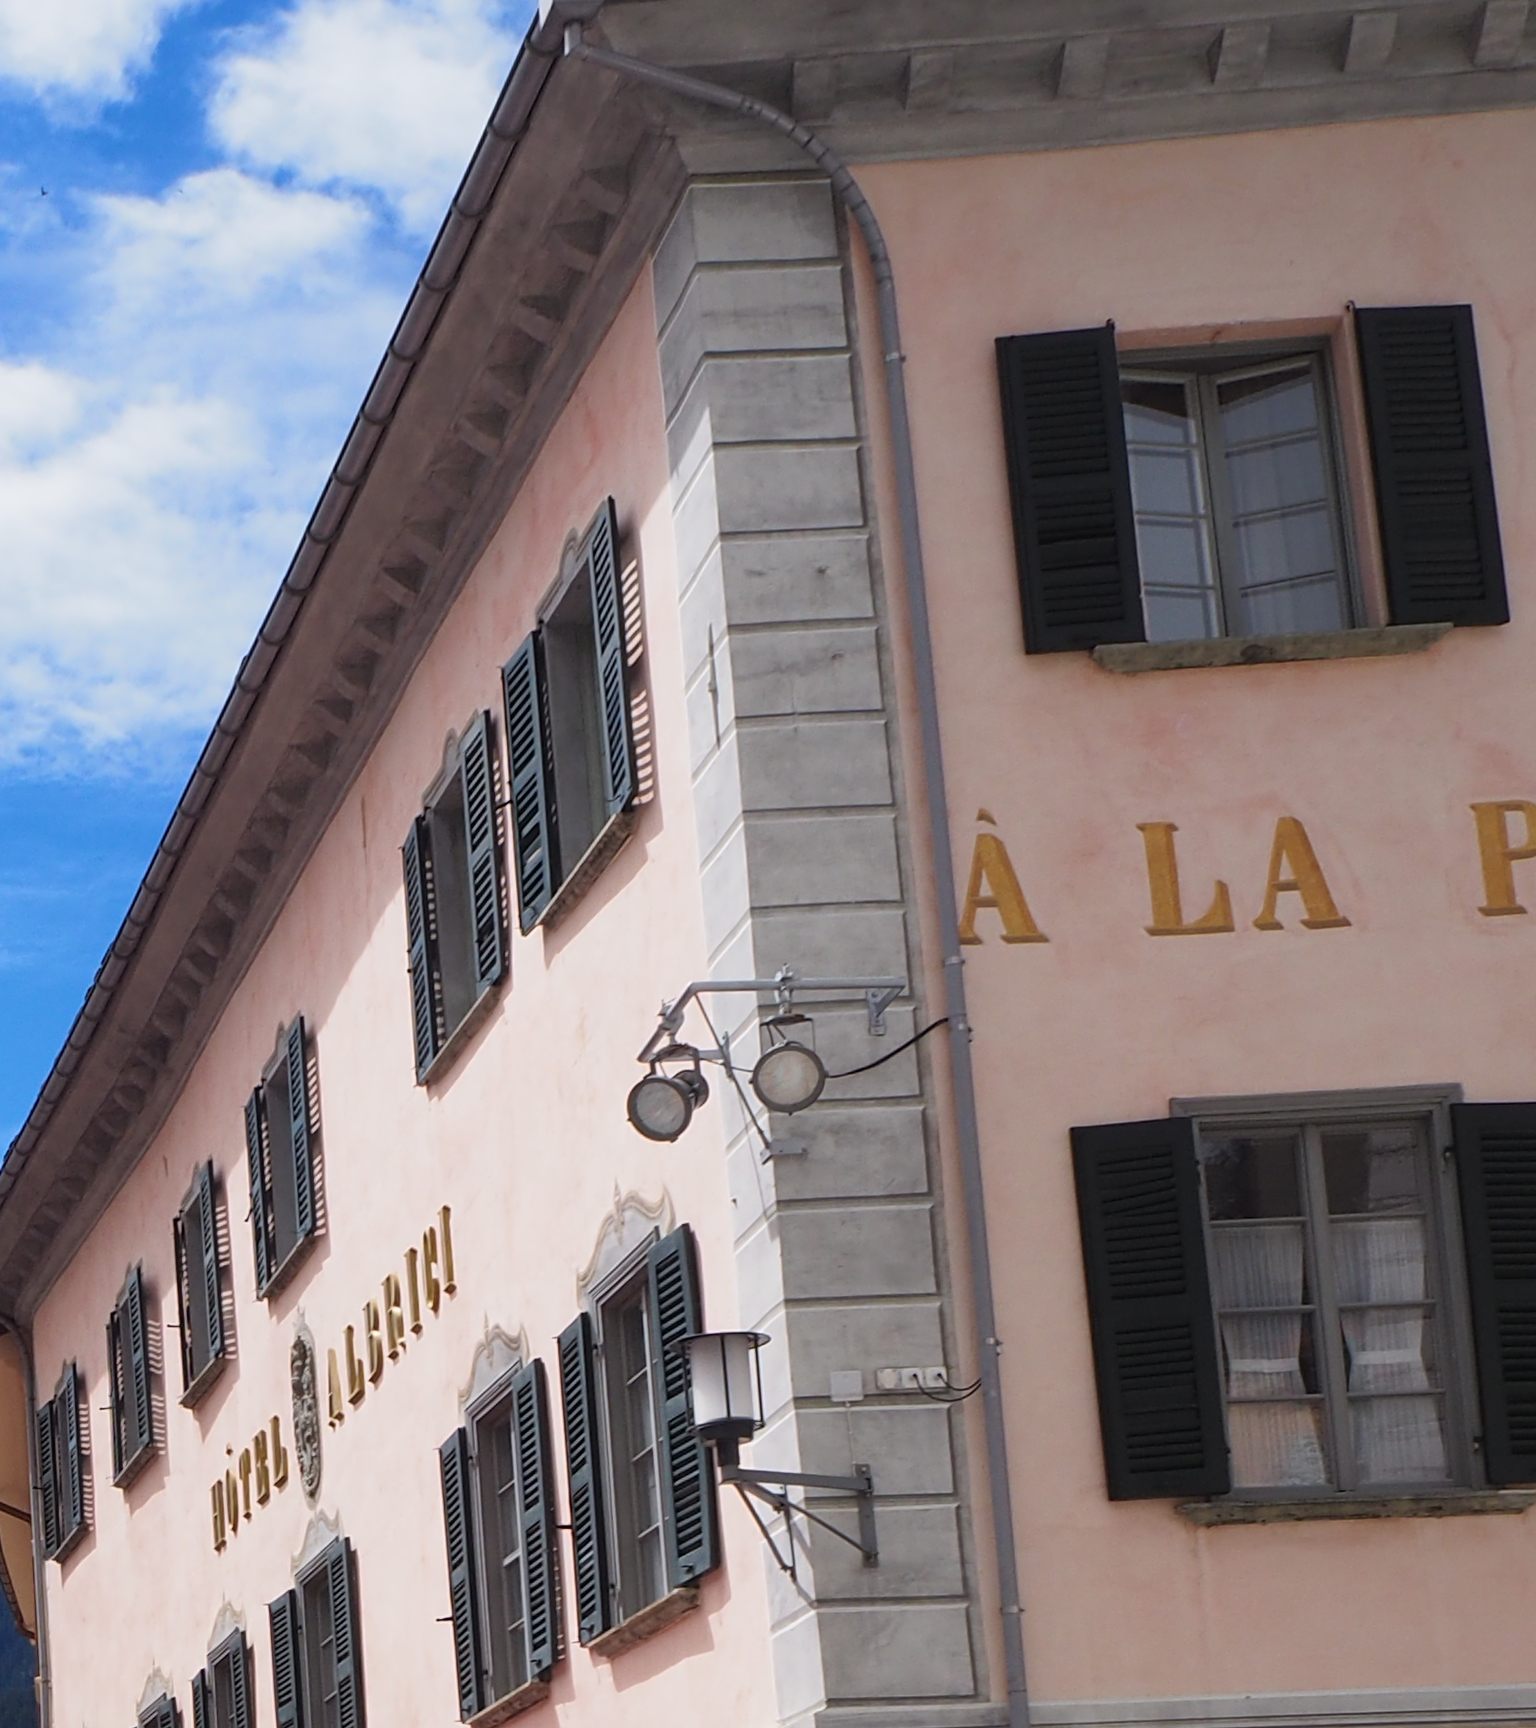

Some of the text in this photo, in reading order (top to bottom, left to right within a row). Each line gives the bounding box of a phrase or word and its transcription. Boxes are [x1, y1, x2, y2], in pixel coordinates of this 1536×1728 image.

[959, 808, 1050, 945] À
[1135, 815, 1352, 937] LA
[327, 1204, 457, 1429] ALBRICI
